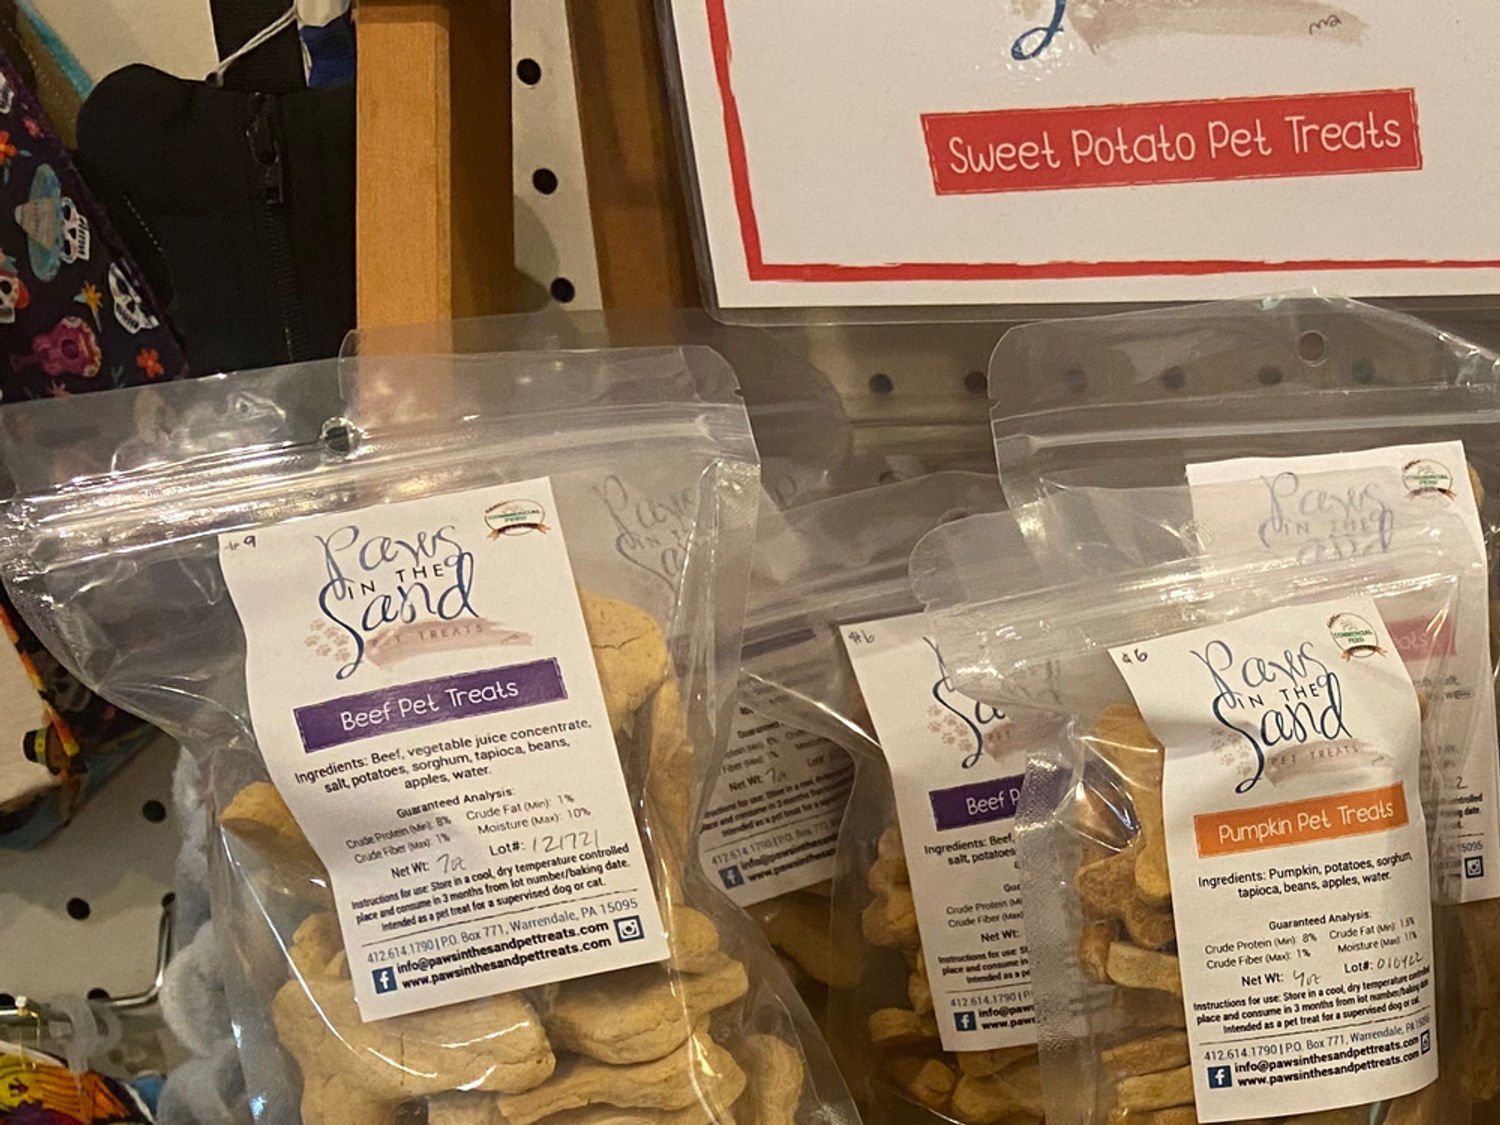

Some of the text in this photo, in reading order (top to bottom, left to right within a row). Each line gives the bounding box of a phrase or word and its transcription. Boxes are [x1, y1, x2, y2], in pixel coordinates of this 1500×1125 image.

[949, 115, 1402, 173] Sweet Potato Pet Treats
[314, 525, 462, 600] Paws
[348, 563, 444, 599] IN THE
[319, 551, 479, 679] Sand
[1190, 639, 1328, 708] Paws
[1236, 682, 1320, 709] IN THE
[340, 679, 519, 731] Beef Pet Treats
[294, 756, 369, 784] Ingredients:
[407, 736, 472, 759] vegetable
[476, 732, 508, 749] juice
[510, 720, 592, 747] concentrate,
[1212, 672, 1353, 794] Sand
[966, 790, 1005, 815] Beef
[1218, 801, 1395, 844] Pumpkin Pet Treats
[489, 840, 525, 857] Lot#:
[1198, 859, 1374, 889] Ingredients: Pumpkin, potatoes,
[396, 919, 609, 974] info@pawsinthesandpettreats.com
[1234, 1036, 1418, 1074] info@pawsinthesandpettreats.com
